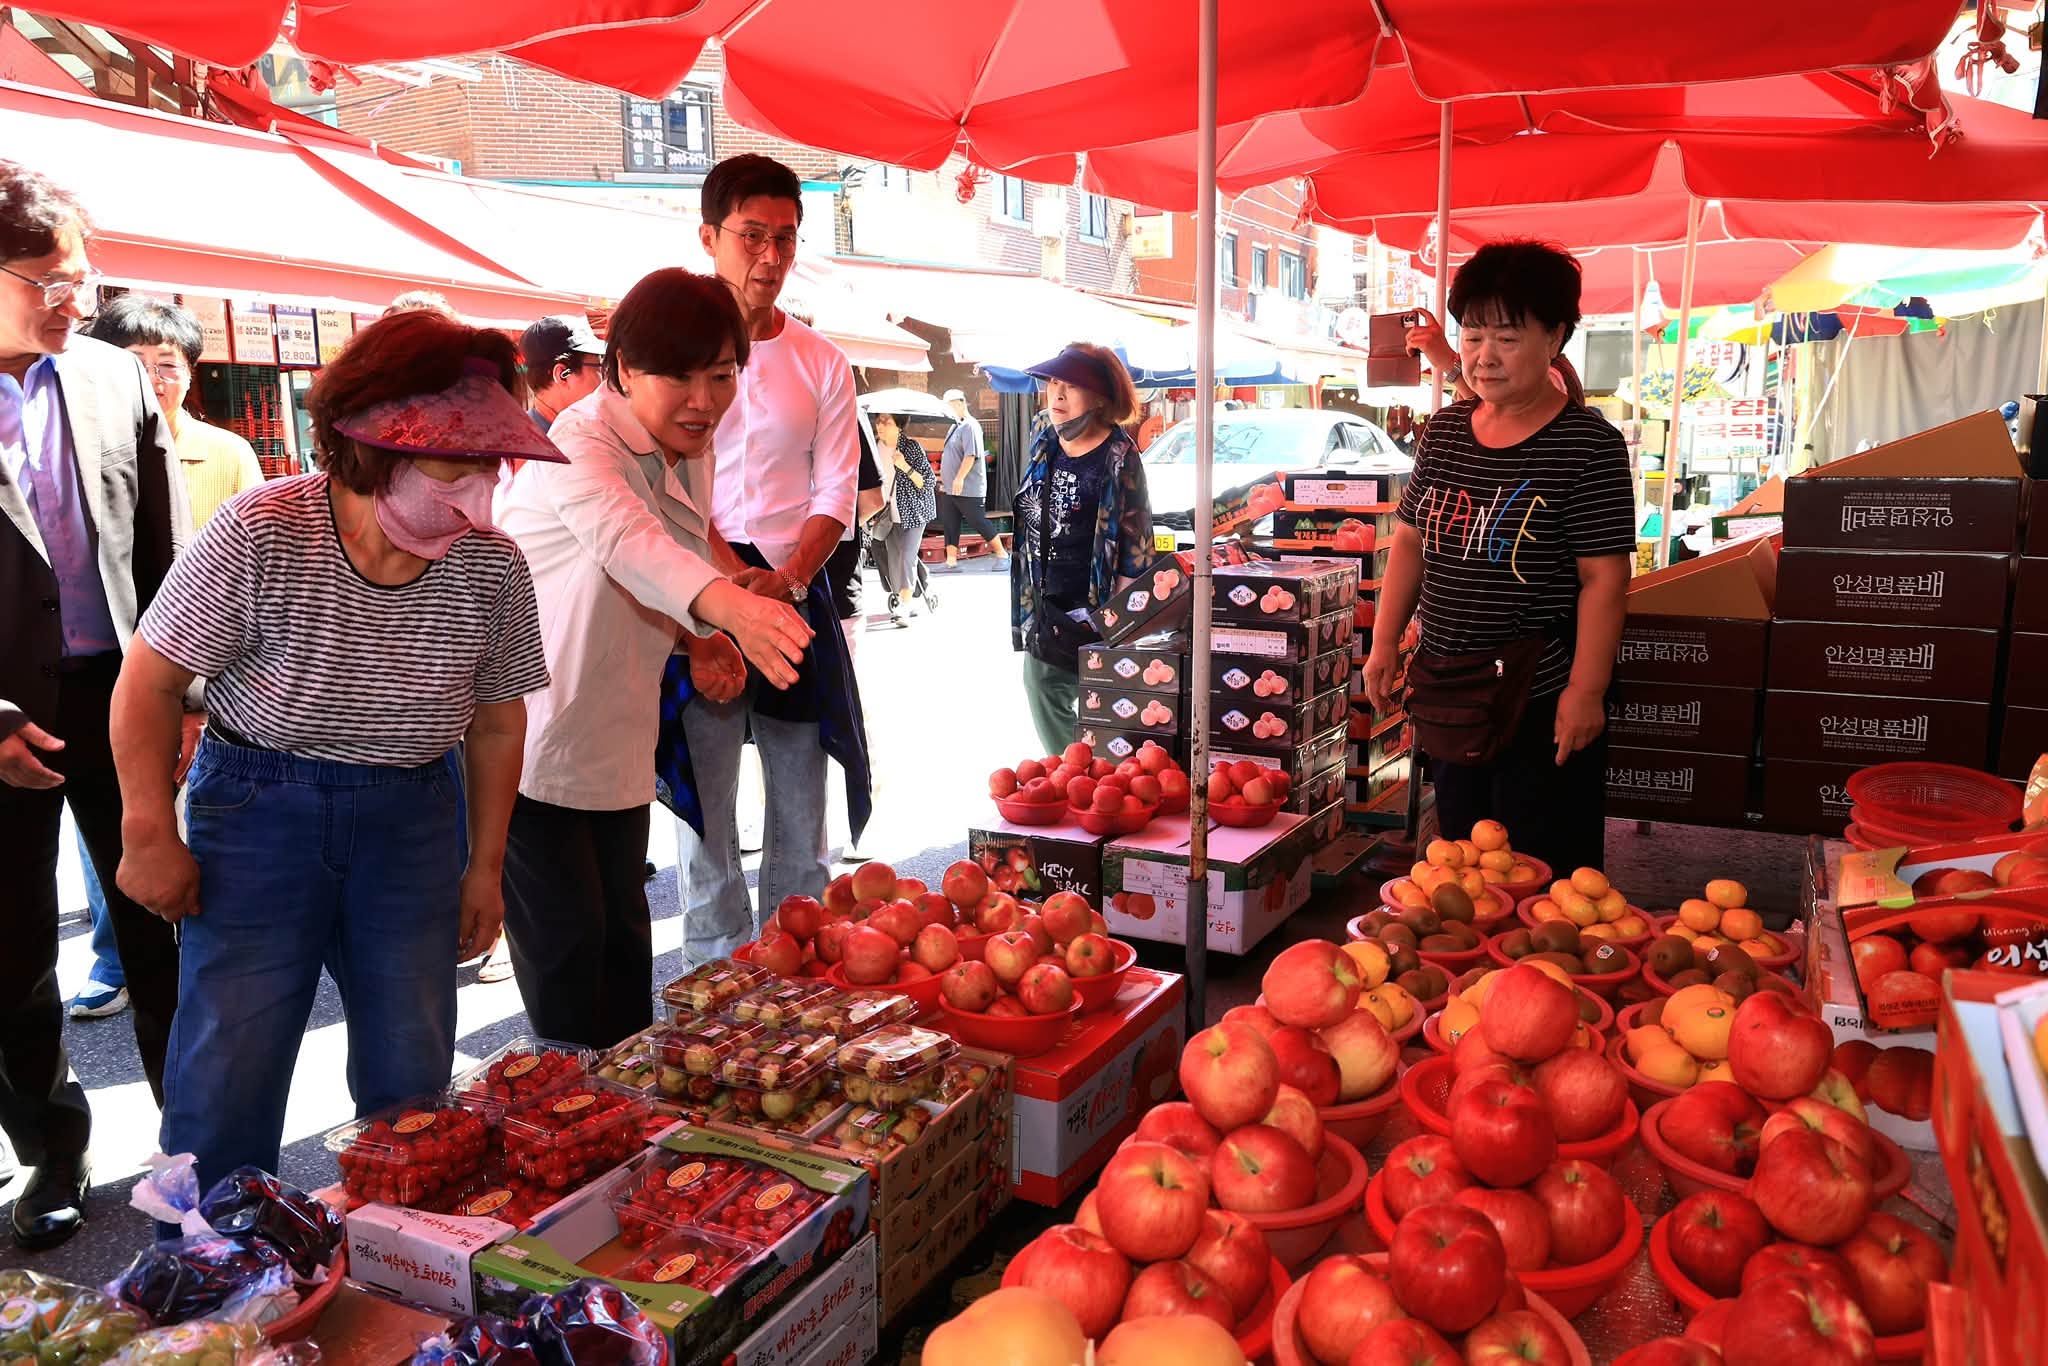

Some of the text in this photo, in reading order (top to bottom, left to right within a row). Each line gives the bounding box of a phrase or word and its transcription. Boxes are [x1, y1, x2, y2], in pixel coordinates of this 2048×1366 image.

[1841, 505, 1954, 532] 안성명품배
[1833, 571, 1944, 598] 안성명품배
[1825, 643, 1935, 670] 안성명품배
[1820, 715, 1928, 741] 안성명품배
[1039, 862, 1074, 879] 사과
[451, 1297, 466, 1312] 3kg
